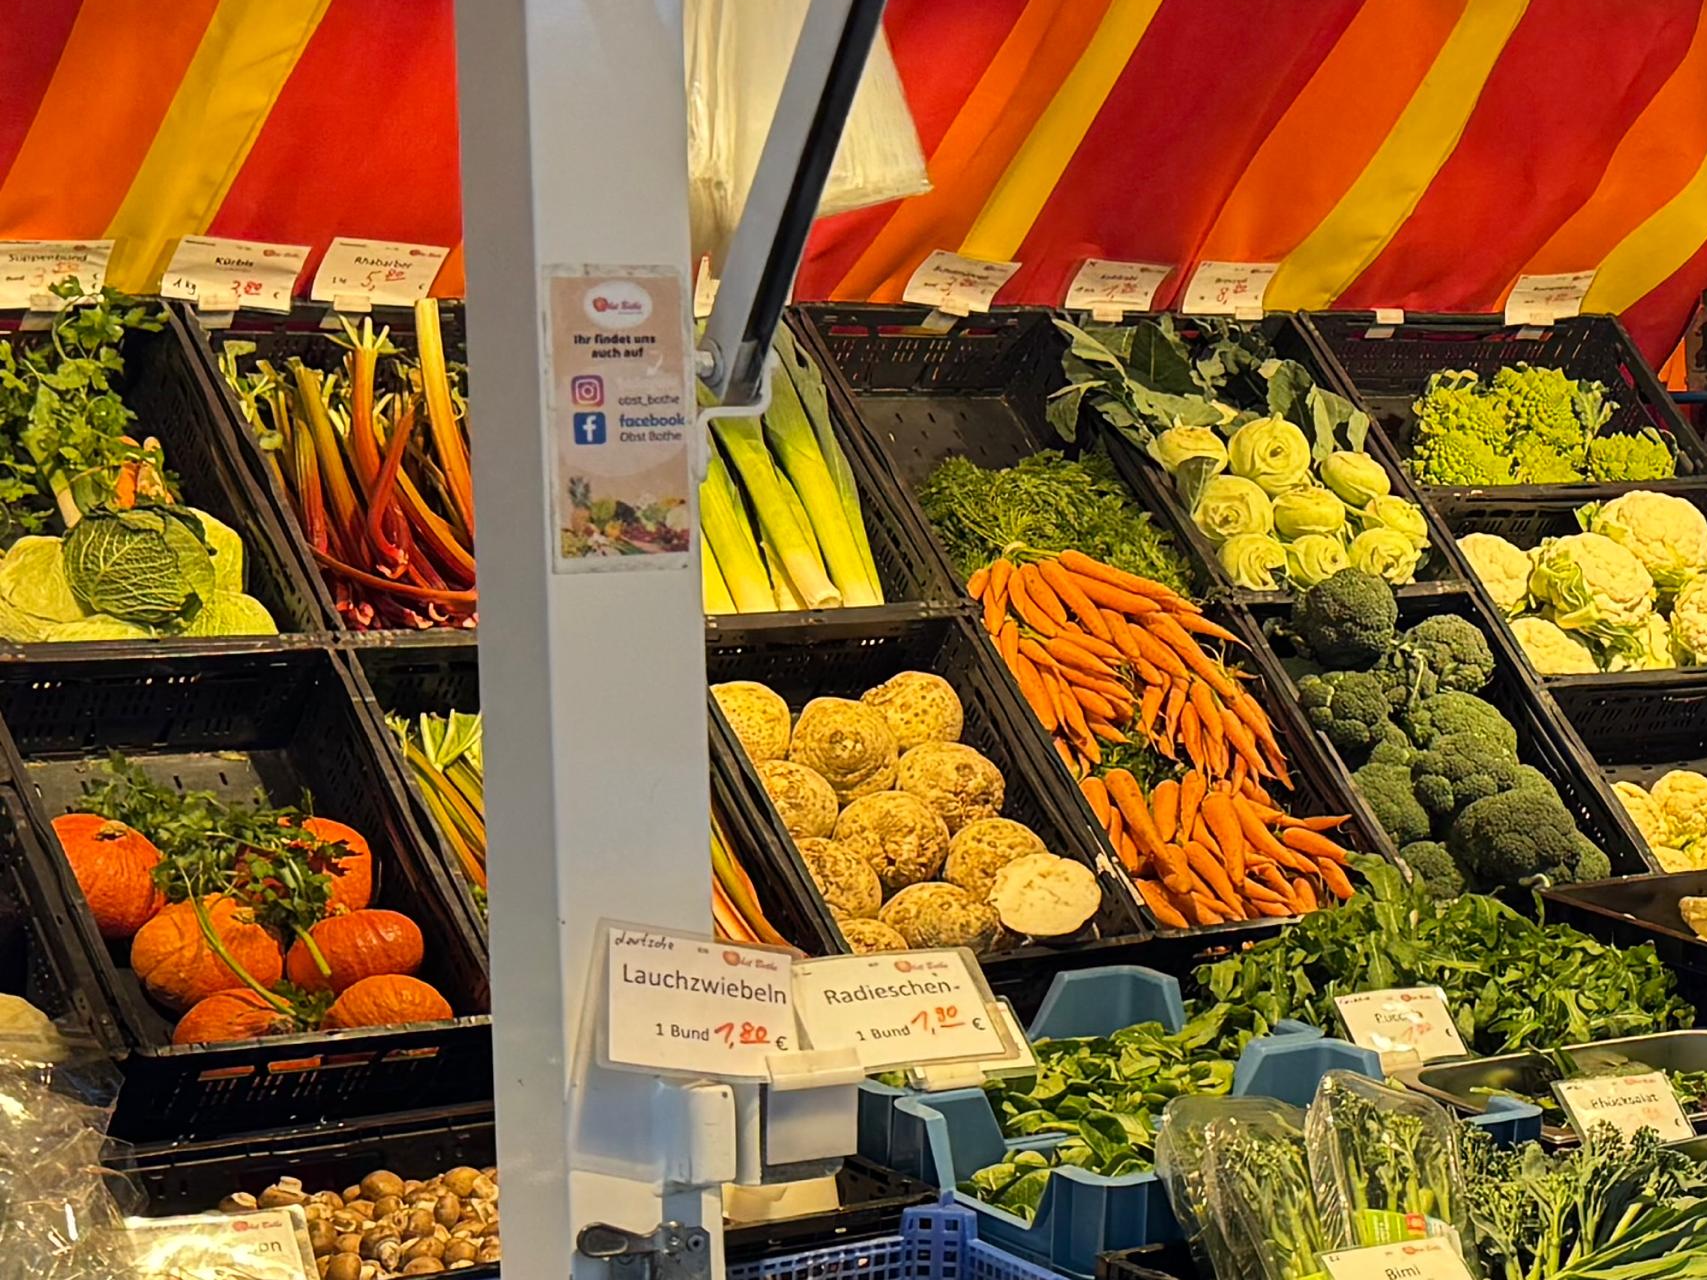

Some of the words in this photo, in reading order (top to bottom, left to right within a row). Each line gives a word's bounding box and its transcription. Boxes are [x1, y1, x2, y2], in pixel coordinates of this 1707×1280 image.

[574, 334, 591, 345] Ihr
[594, 333, 631, 345] findet
[634, 335, 656, 345] uns
[591, 347, 621, 359] auch
[623, 347, 644, 359] auf
[619, 413, 686, 428] facebook
[620, 431, 647, 443] Obst
[649, 430, 682, 442] Bothe
[623, 962, 787, 1005] Lauchzwiebeln
[856, 1030, 866, 1041] 1
[871, 1025, 911, 1040] Bund
[972, 1017, 986, 1031] €
[655, 1023, 664, 1037] 1
[670, 1024, 710, 1042] Bund
[775, 1036, 789, 1051] €
[1384, 1264, 1422, 1280] Bimi
